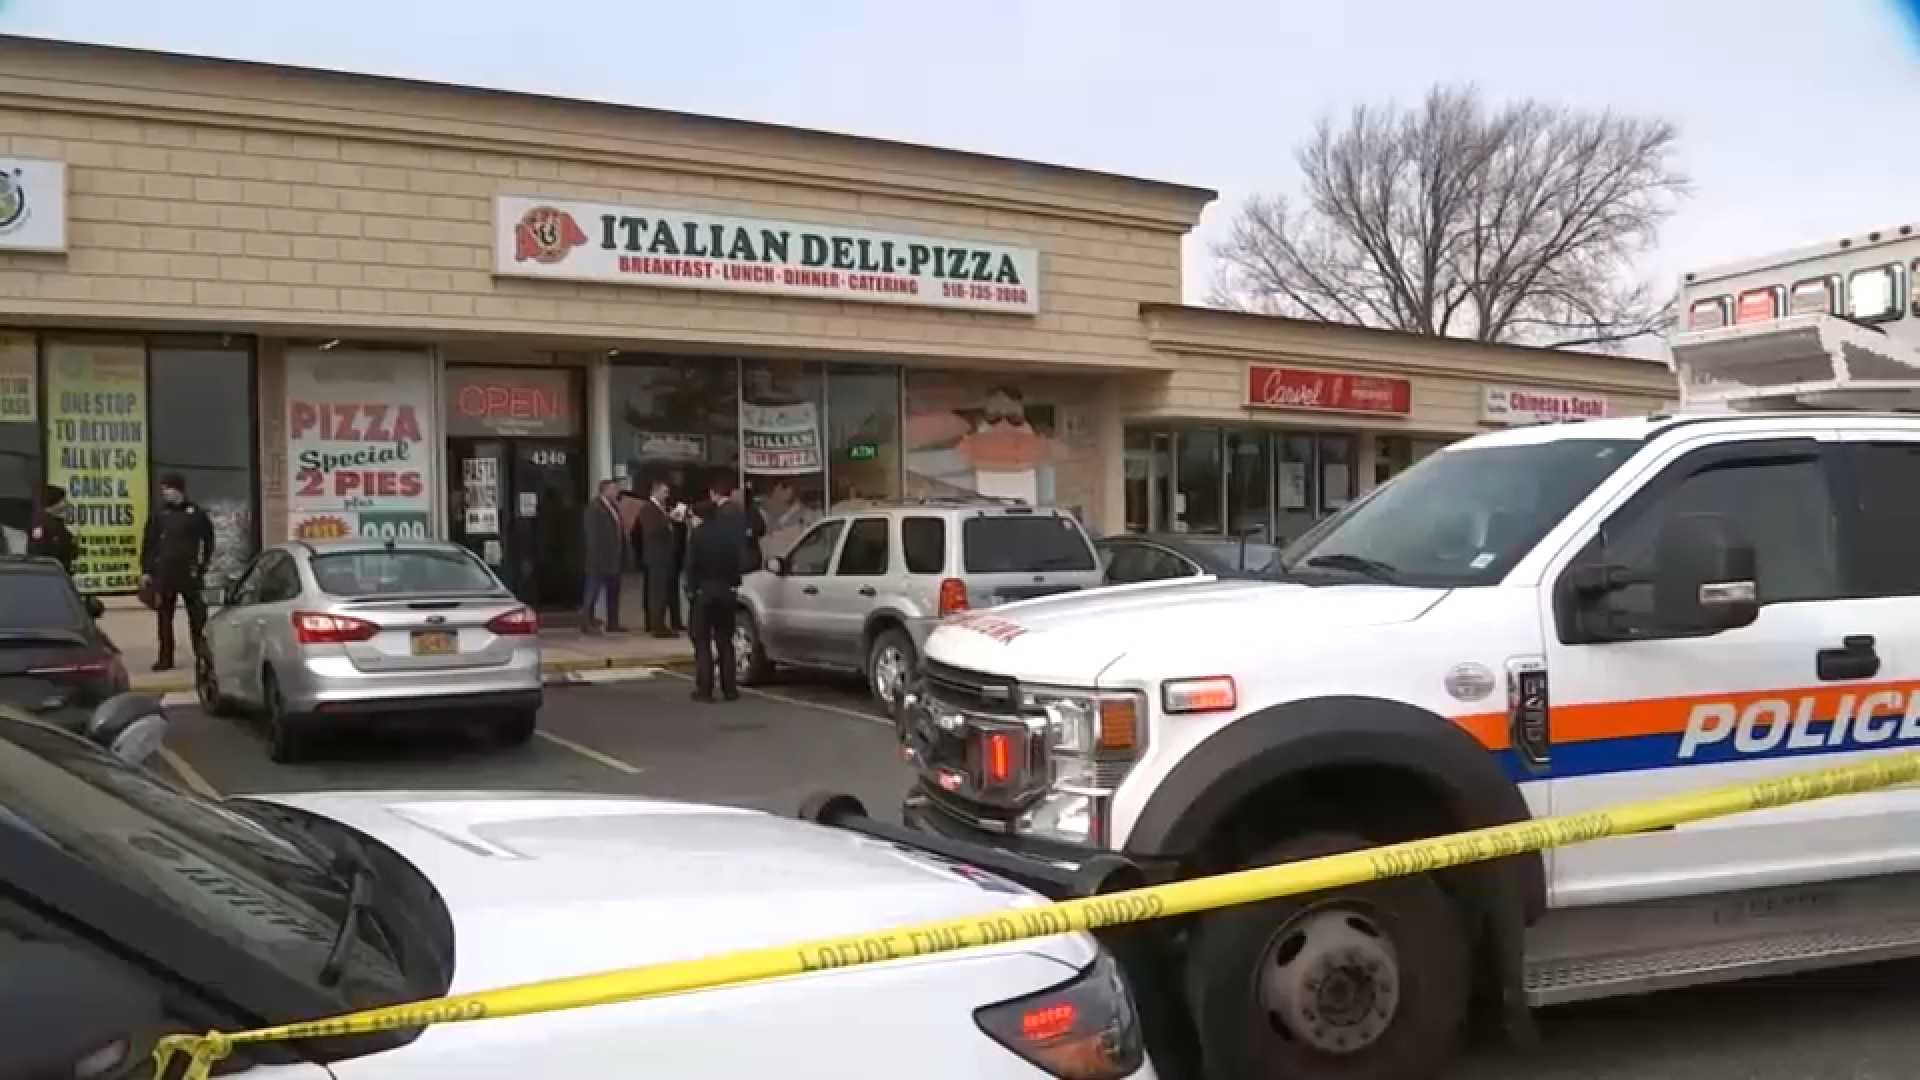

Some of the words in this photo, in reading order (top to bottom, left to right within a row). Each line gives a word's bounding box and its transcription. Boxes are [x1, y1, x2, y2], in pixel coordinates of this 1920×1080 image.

[600, 213, 791, 264] ITALIAN
[619, 255, 712, 279] BREAKFAST
[723, 263, 775, 283] LUNCH
[783, 269, 840, 289] DINNER
[848, 274, 919, 295] CATERING
[1262, 369, 1323, 405] Carvel
[60, 391, 92, 414] ONE
[95, 391, 137, 415] STOP
[459, 384, 563, 419] OPEN
[1511, 390, 1559, 413] Chinese
[1571, 397, 1603, 416] Sushi
[55, 419, 76, 441] TO
[79, 419, 142, 443] RETURN
[290, 401, 422, 442] PIZZA
[61, 447, 88, 470] ALL
[90, 447, 111, 470] NY
[299, 439, 410, 473] Special
[850, 445, 875, 458] ATM
[69, 475, 113, 497] CANS
[117, 479, 129, 497] &
[296, 468, 325, 497] 2
[334, 470, 424, 497] PIES
[64, 503, 135, 527] BOTTLES
